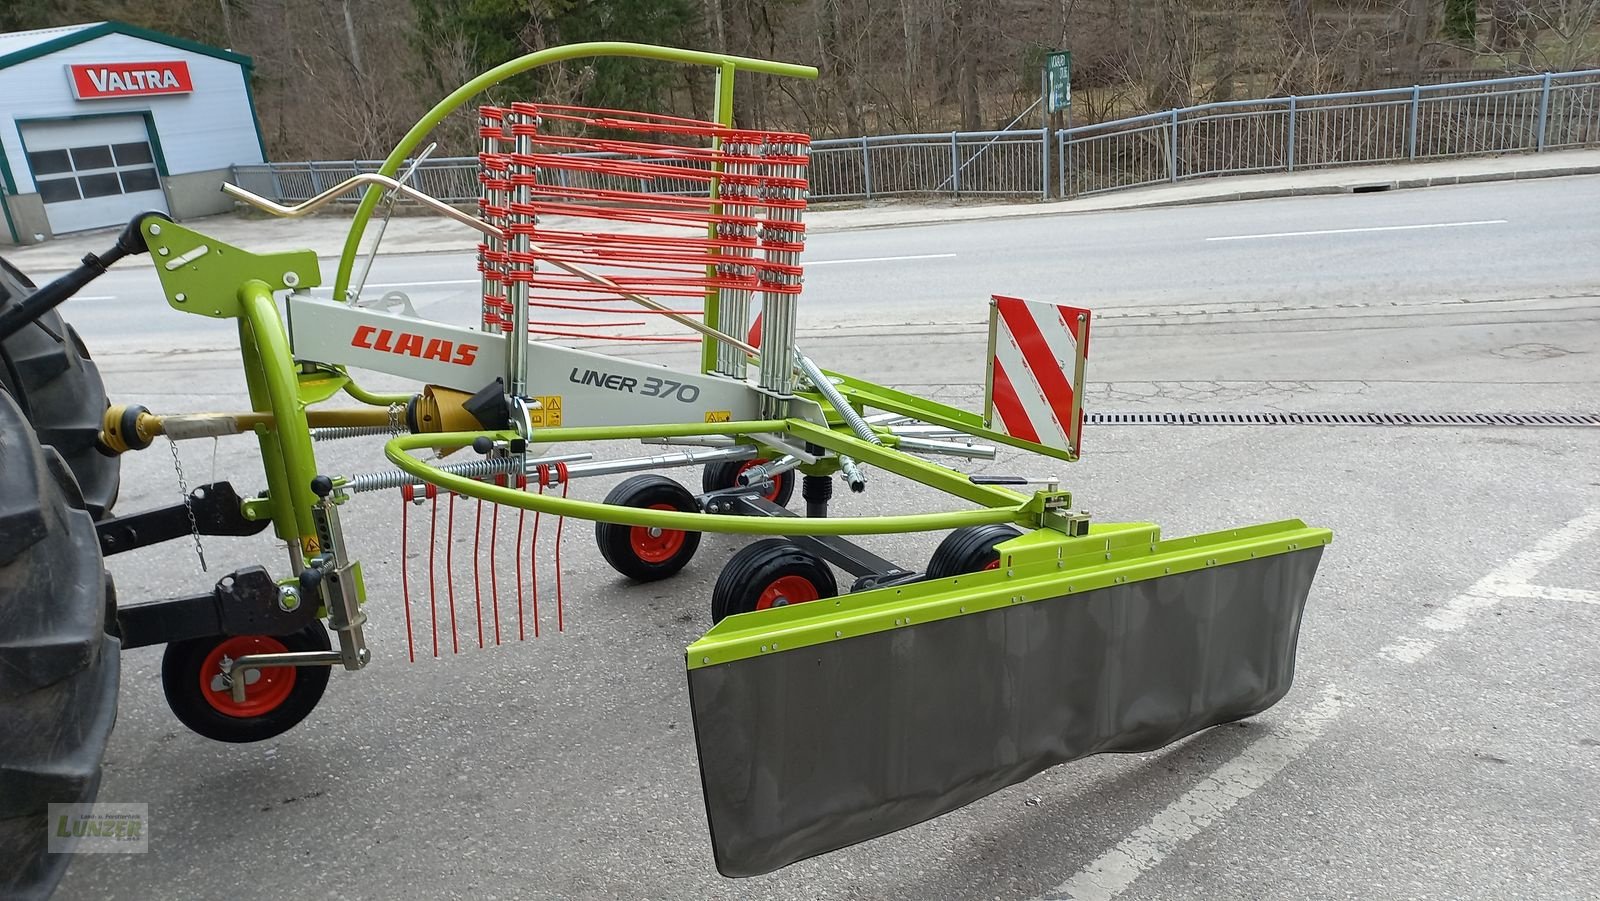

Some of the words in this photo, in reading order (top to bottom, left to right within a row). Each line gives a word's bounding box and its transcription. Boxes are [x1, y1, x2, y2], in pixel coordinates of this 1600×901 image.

[86, 69, 180, 92] VALTRA
[351, 325, 479, 366] CLAAS
[569, 367, 638, 393] LINER
[640, 376, 700, 403] 370
